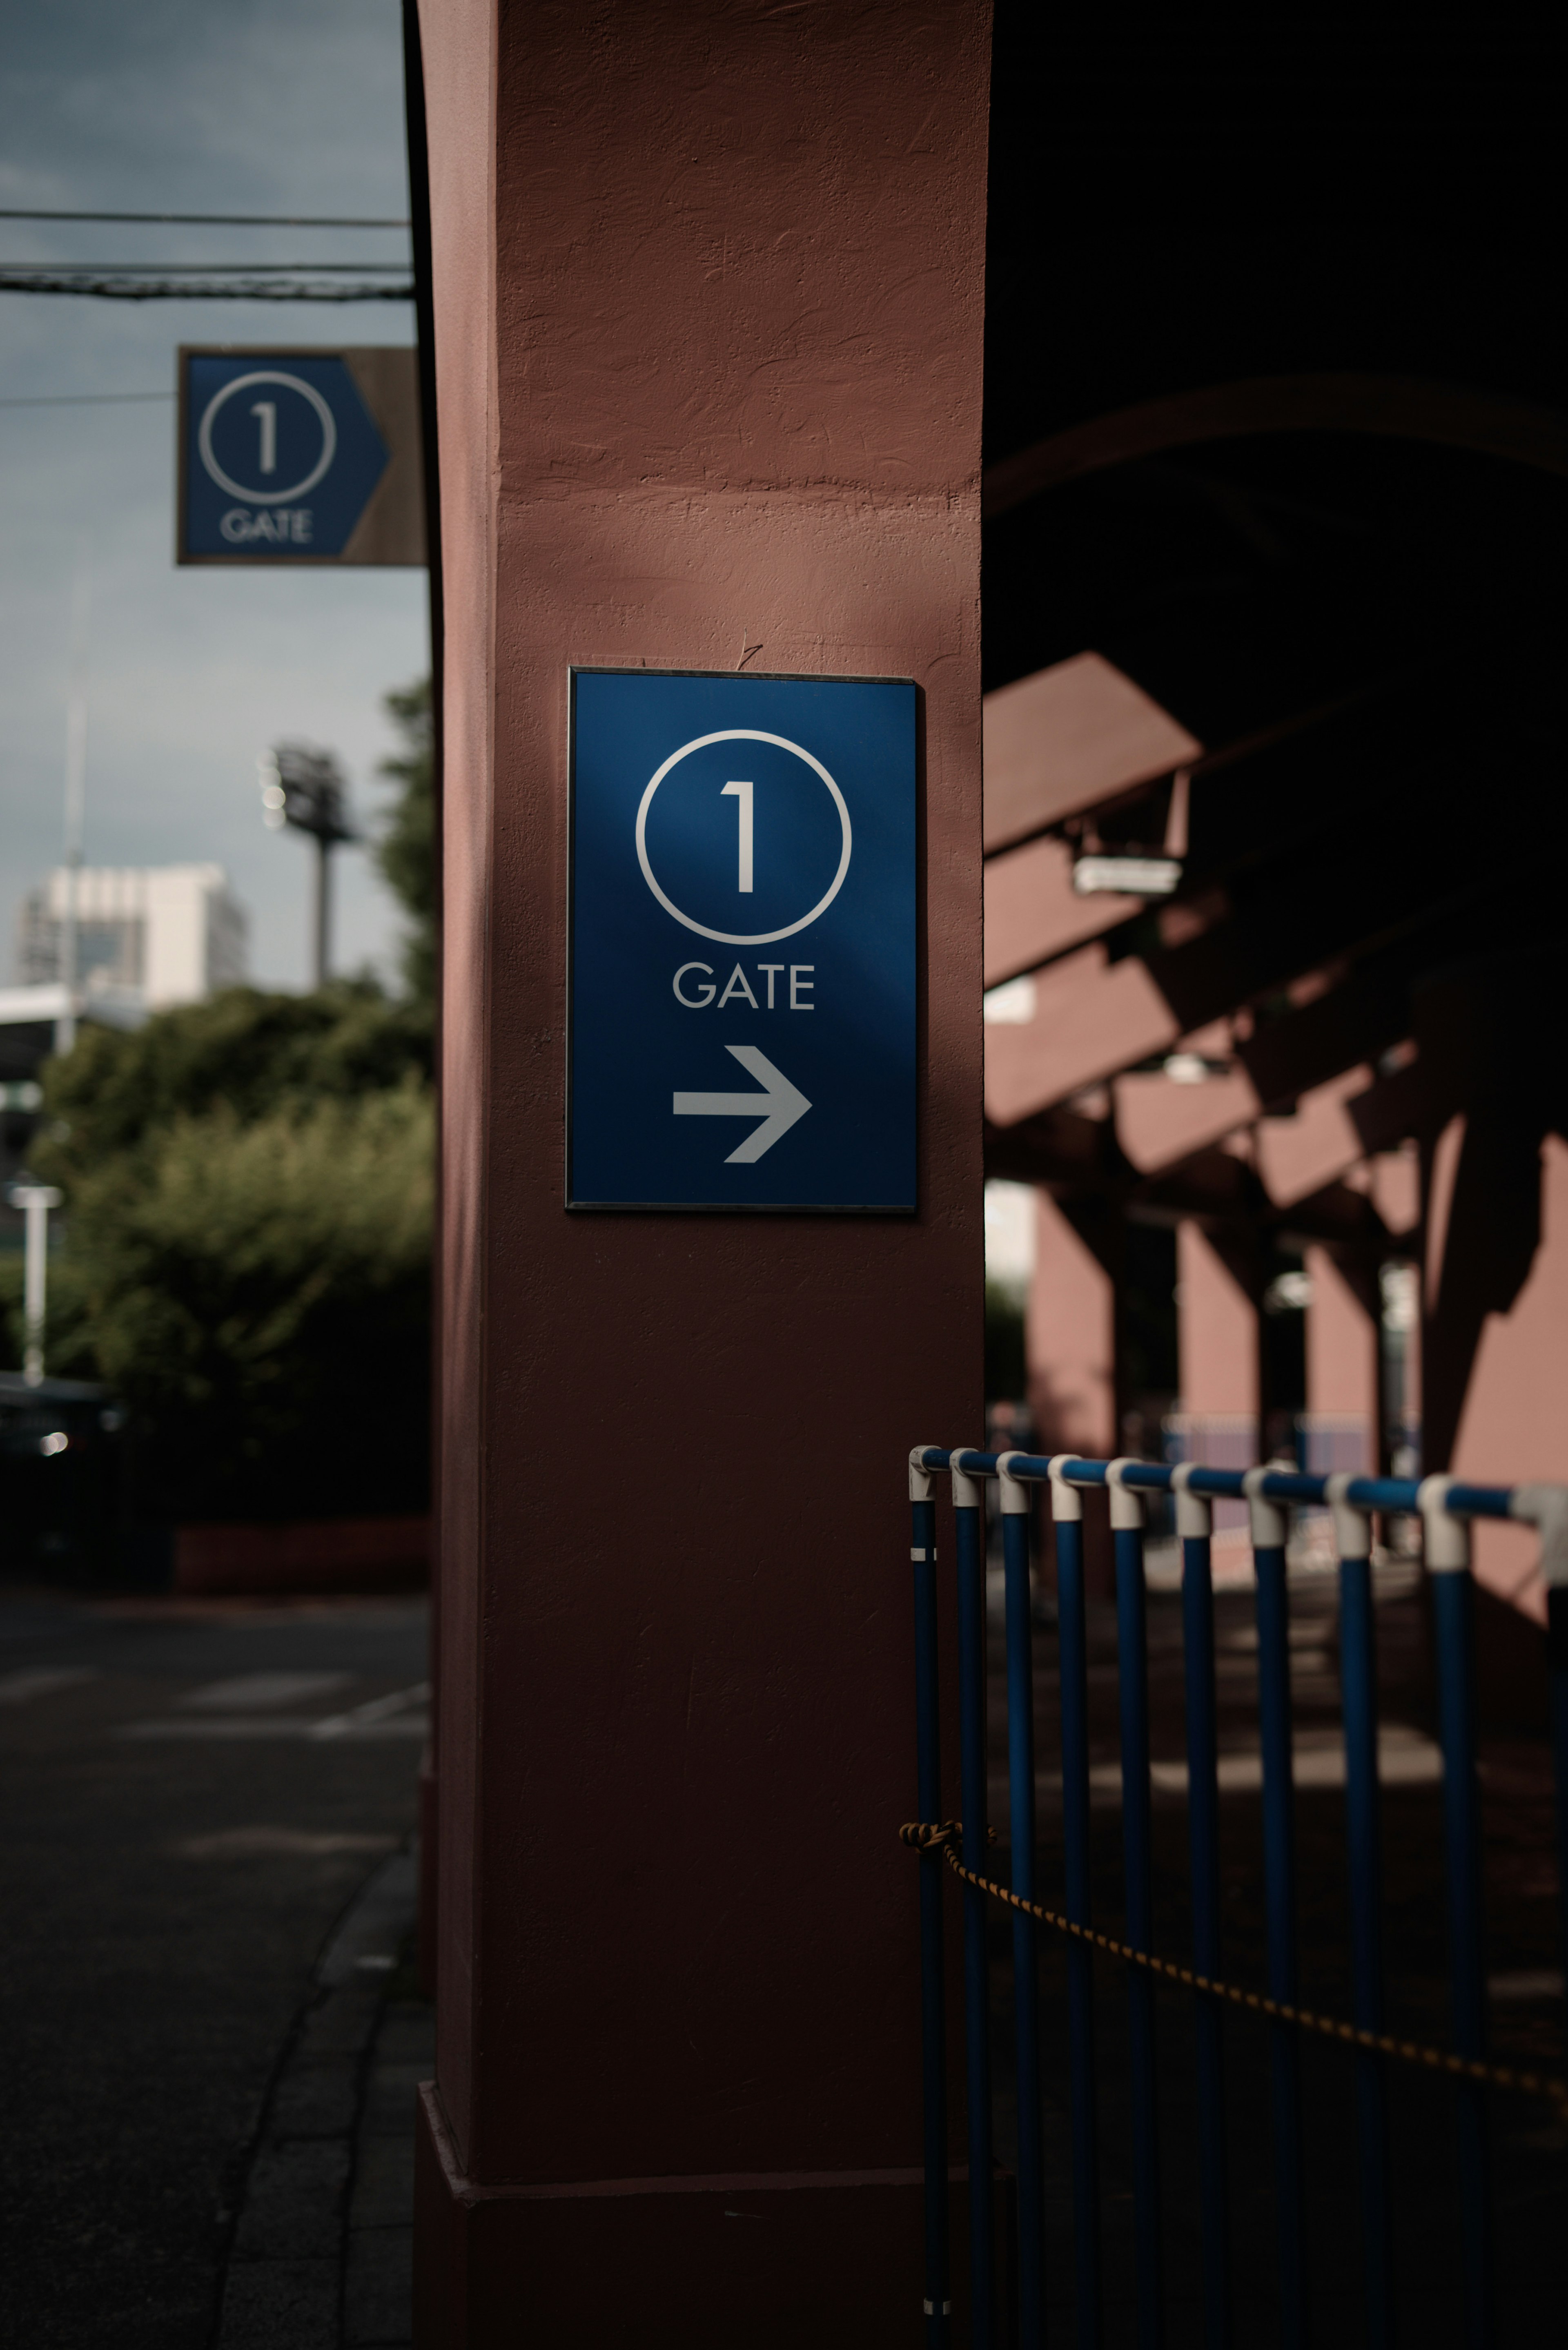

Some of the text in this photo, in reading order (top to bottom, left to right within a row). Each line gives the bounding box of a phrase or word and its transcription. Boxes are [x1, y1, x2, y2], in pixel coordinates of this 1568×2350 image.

[251, 401, 276, 474] 1
[220, 508, 313, 543] GATE
[720, 781, 754, 893] 1
[672, 961, 815, 1010] GATE
